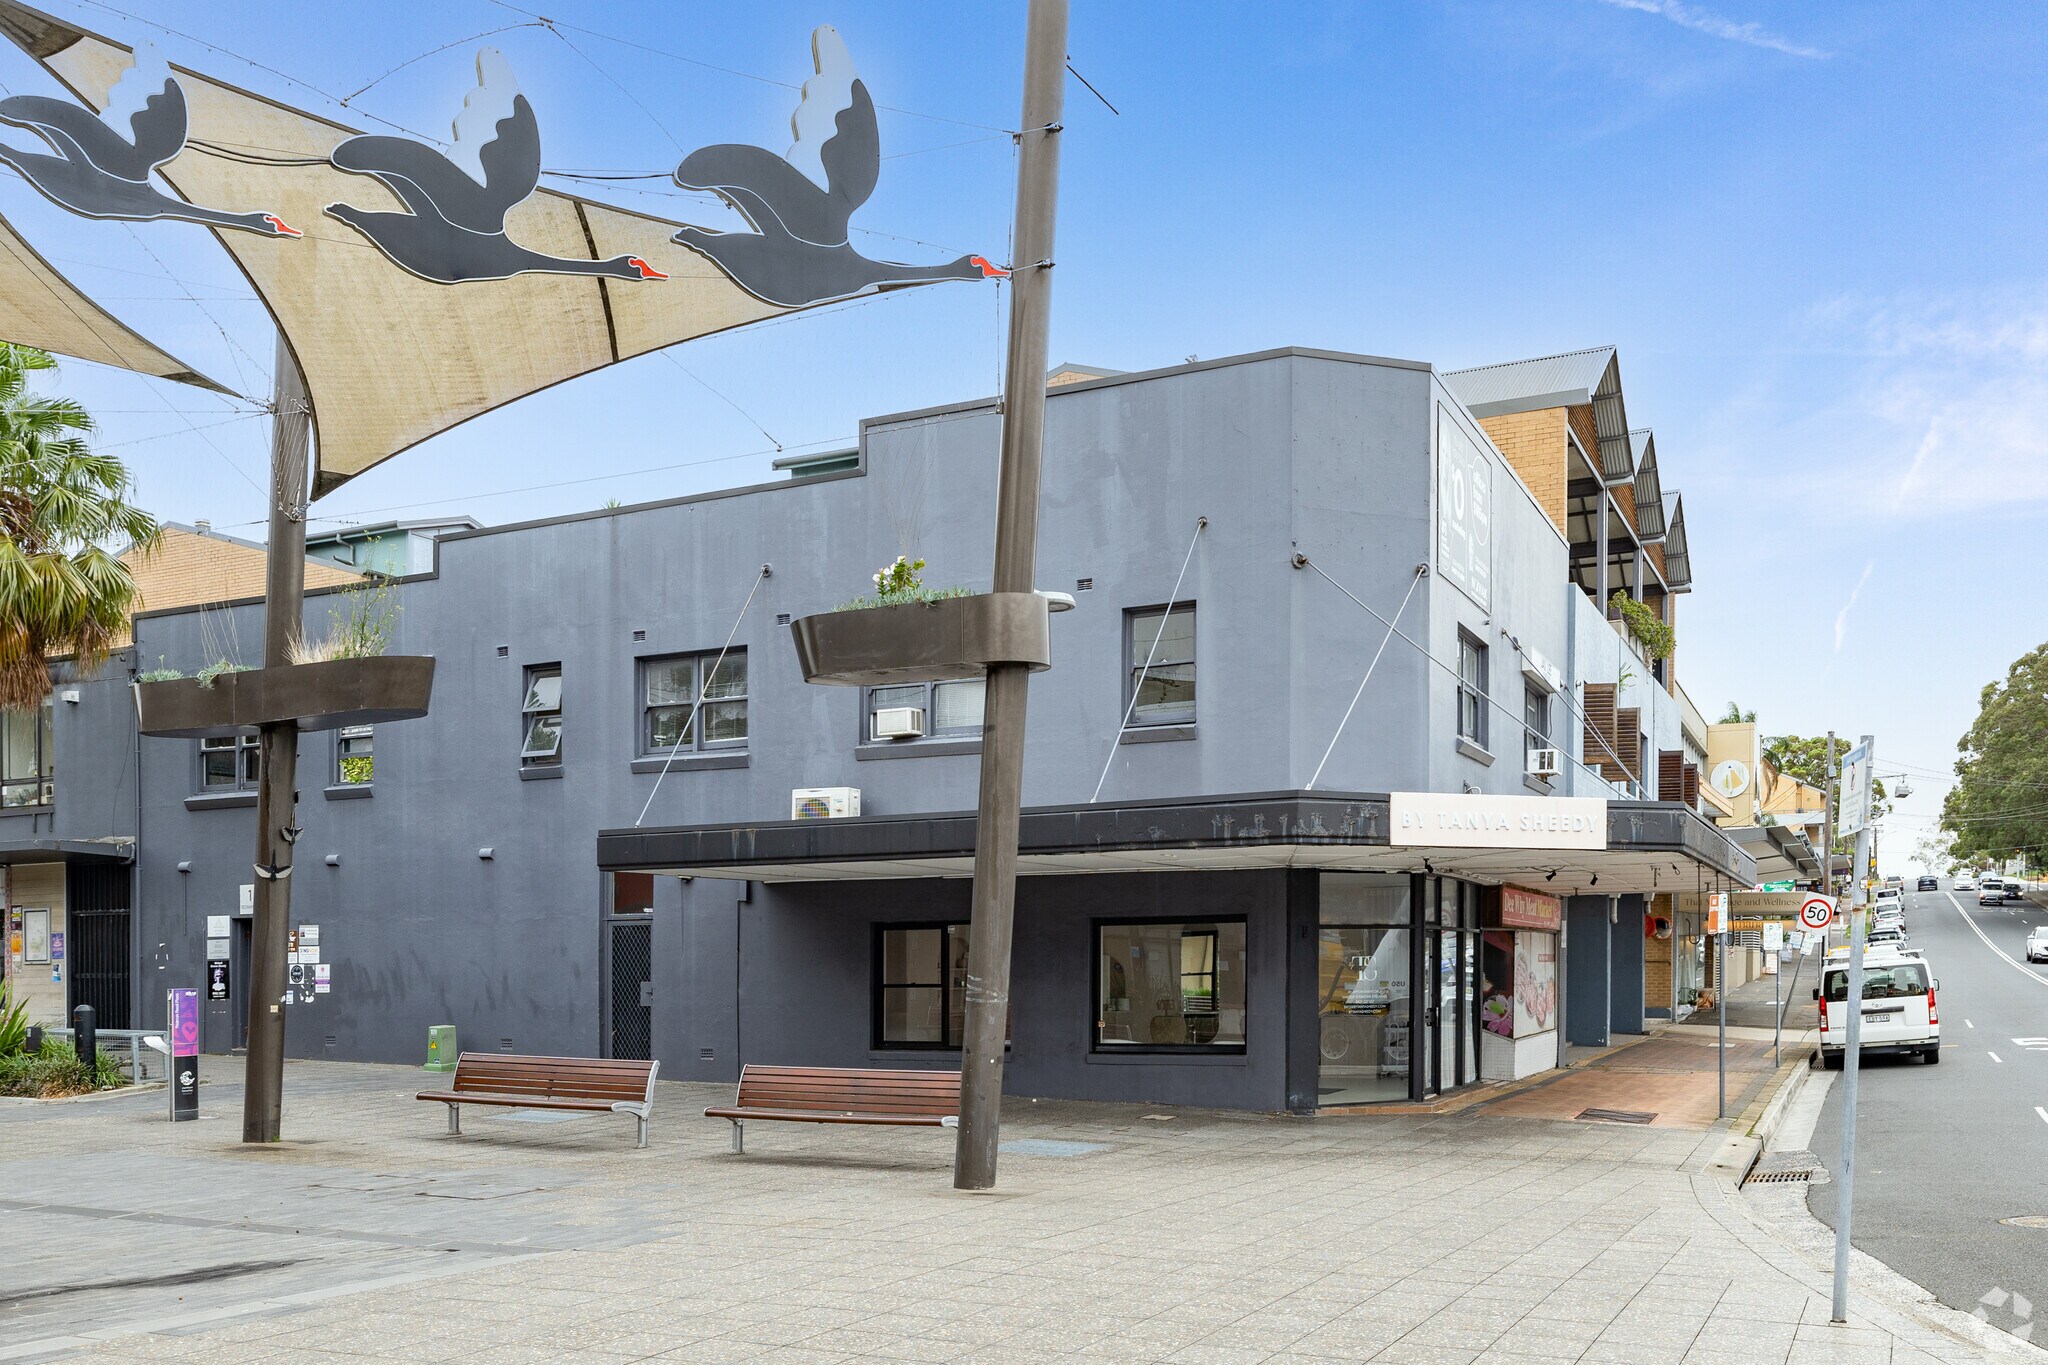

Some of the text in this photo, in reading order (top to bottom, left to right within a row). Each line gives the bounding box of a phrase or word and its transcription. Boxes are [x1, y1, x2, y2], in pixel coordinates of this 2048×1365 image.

[1402, 810, 1599, 833] BY TANYA SHEEDY
[1504, 892, 1514, 913] Dee
[1515, 894, 1526, 919] Why
[1526, 896, 1538, 916] Meat
[1744, 897, 1761, 906] and
[1763, 897, 1801, 906] Wellness
[1806, 906, 1827, 922] 50
